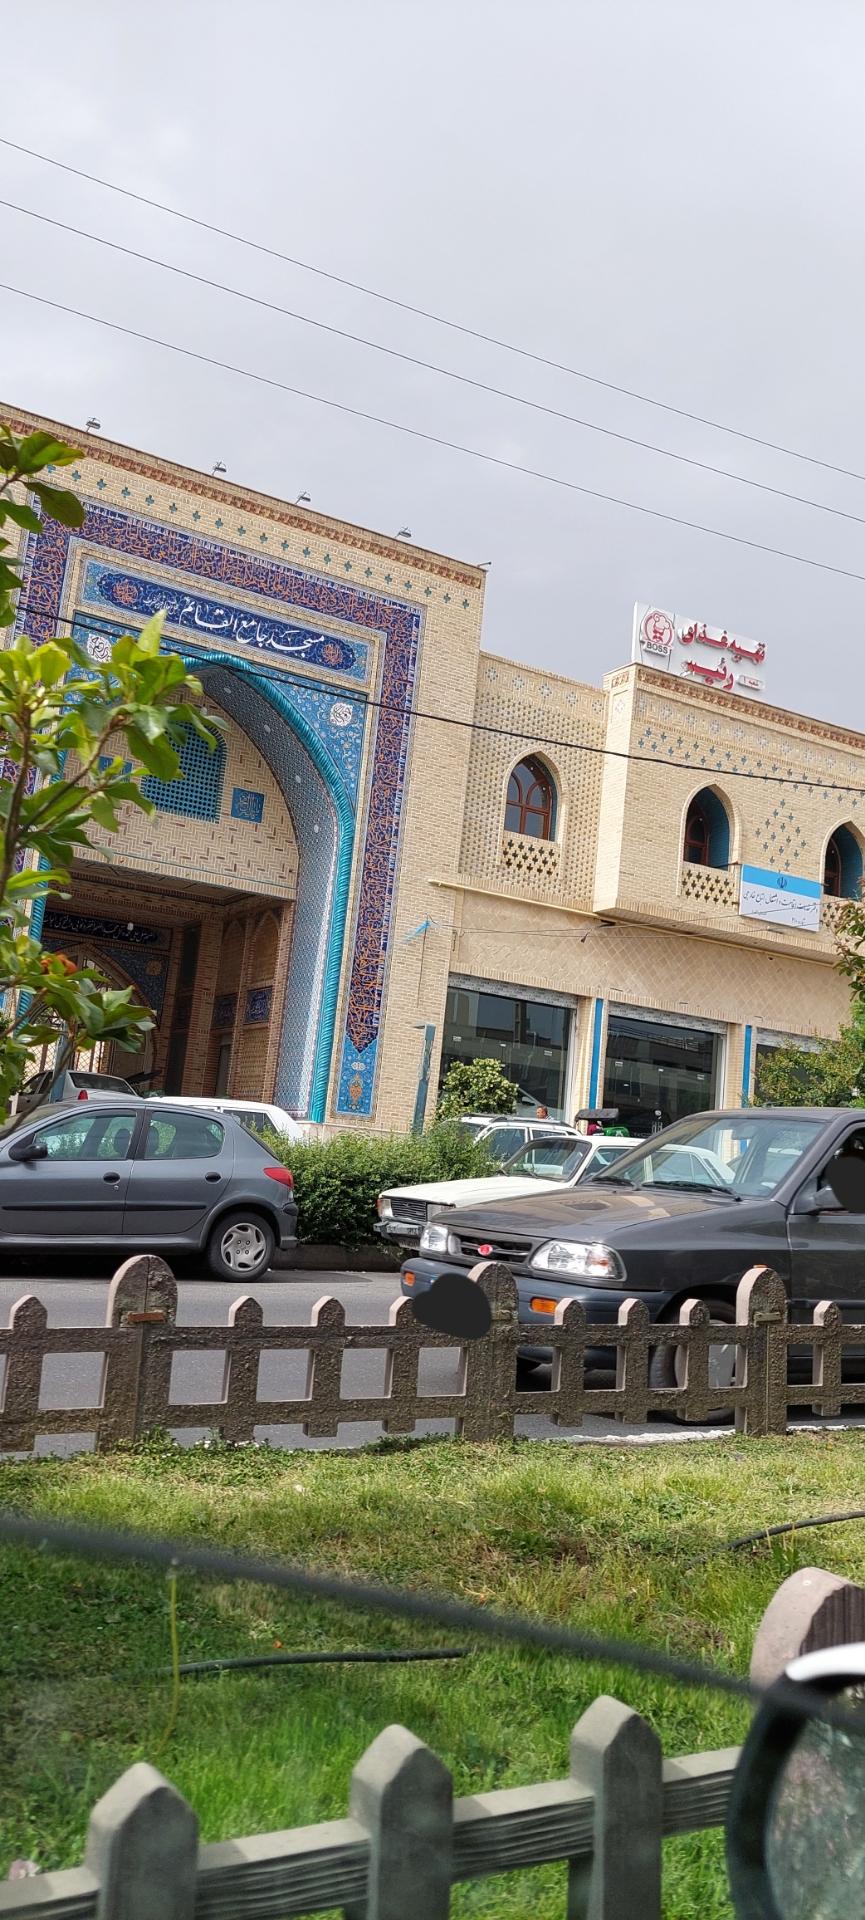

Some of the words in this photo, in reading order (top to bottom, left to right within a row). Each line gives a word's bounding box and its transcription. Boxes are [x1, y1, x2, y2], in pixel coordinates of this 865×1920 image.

[178, 597, 238, 632] القائم
[236, 617, 267, 648] جامع
[267, 629, 325, 658] مسجد
[680, 622, 728, 649] غذای
[646, 641, 669, 655] BOSS
